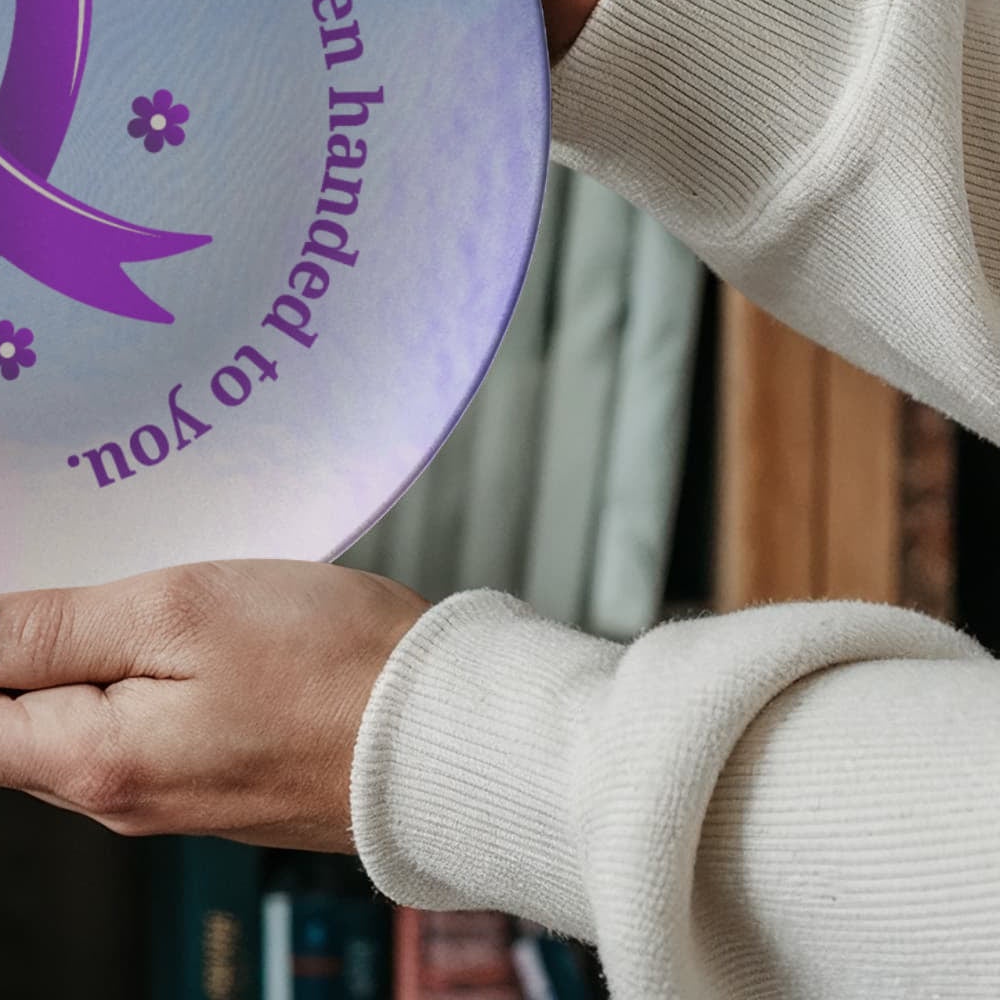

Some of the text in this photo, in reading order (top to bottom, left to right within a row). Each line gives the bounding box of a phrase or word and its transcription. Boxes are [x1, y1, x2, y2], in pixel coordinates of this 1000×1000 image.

[262, 84, 385, 349] handed
[210, 343, 280, 407] to
[67, 384, 213, 488] you.
